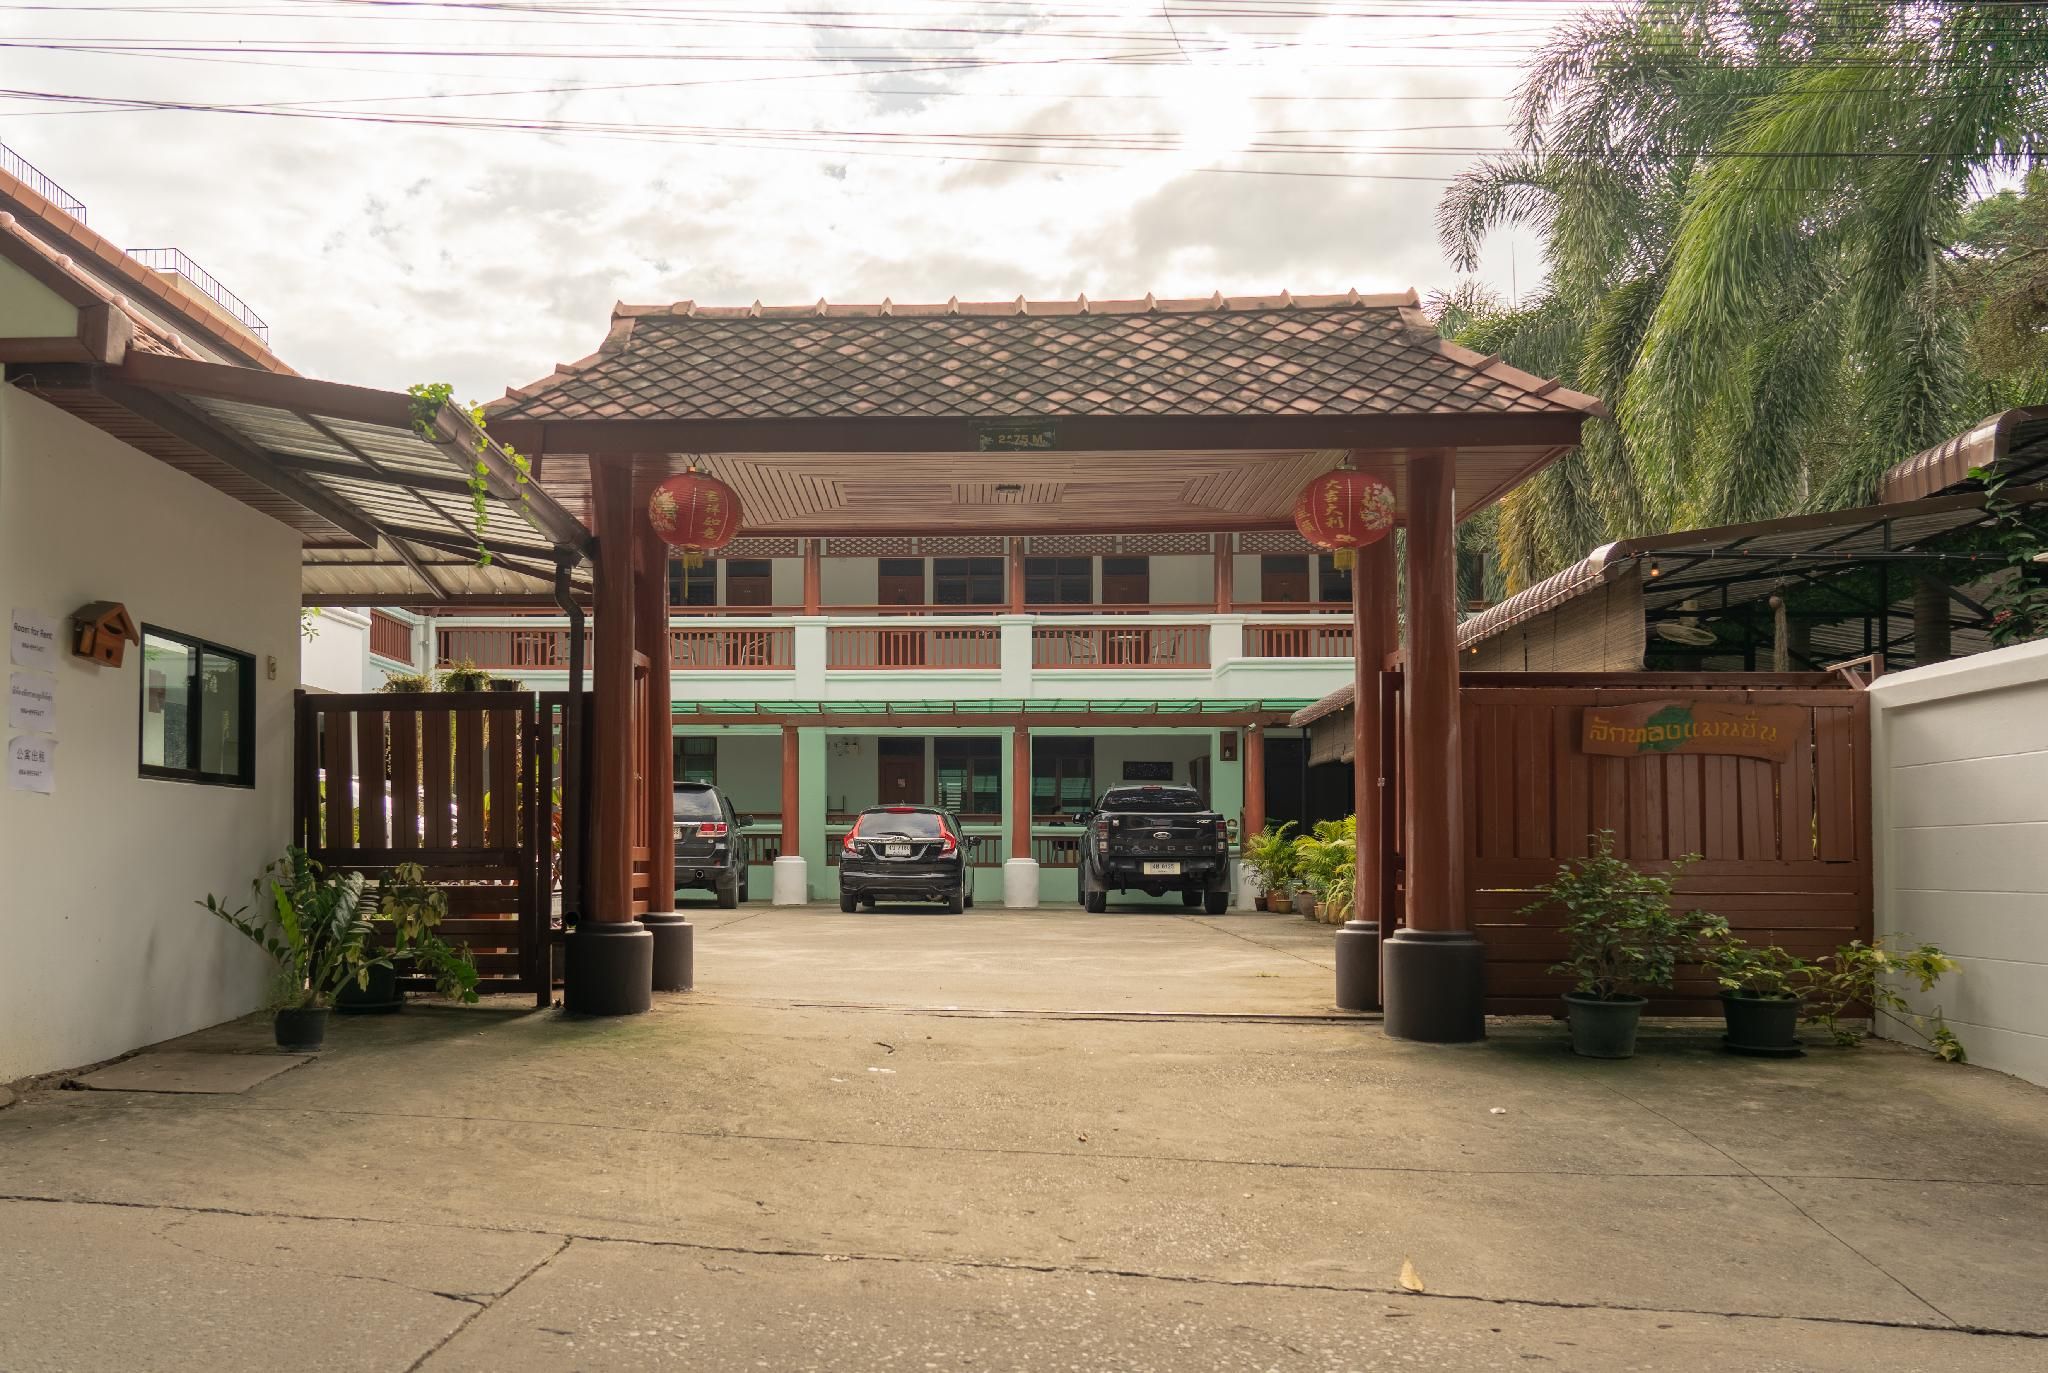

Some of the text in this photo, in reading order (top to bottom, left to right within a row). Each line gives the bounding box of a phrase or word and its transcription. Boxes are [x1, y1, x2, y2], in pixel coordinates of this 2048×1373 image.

[703, 489, 721, 540] 吉祥如意
[1324, 479, 1345, 529] 大吉大利
[13, 622, 53, 640] Room for Rent
[16, 747, 46, 763] 公寓出租
